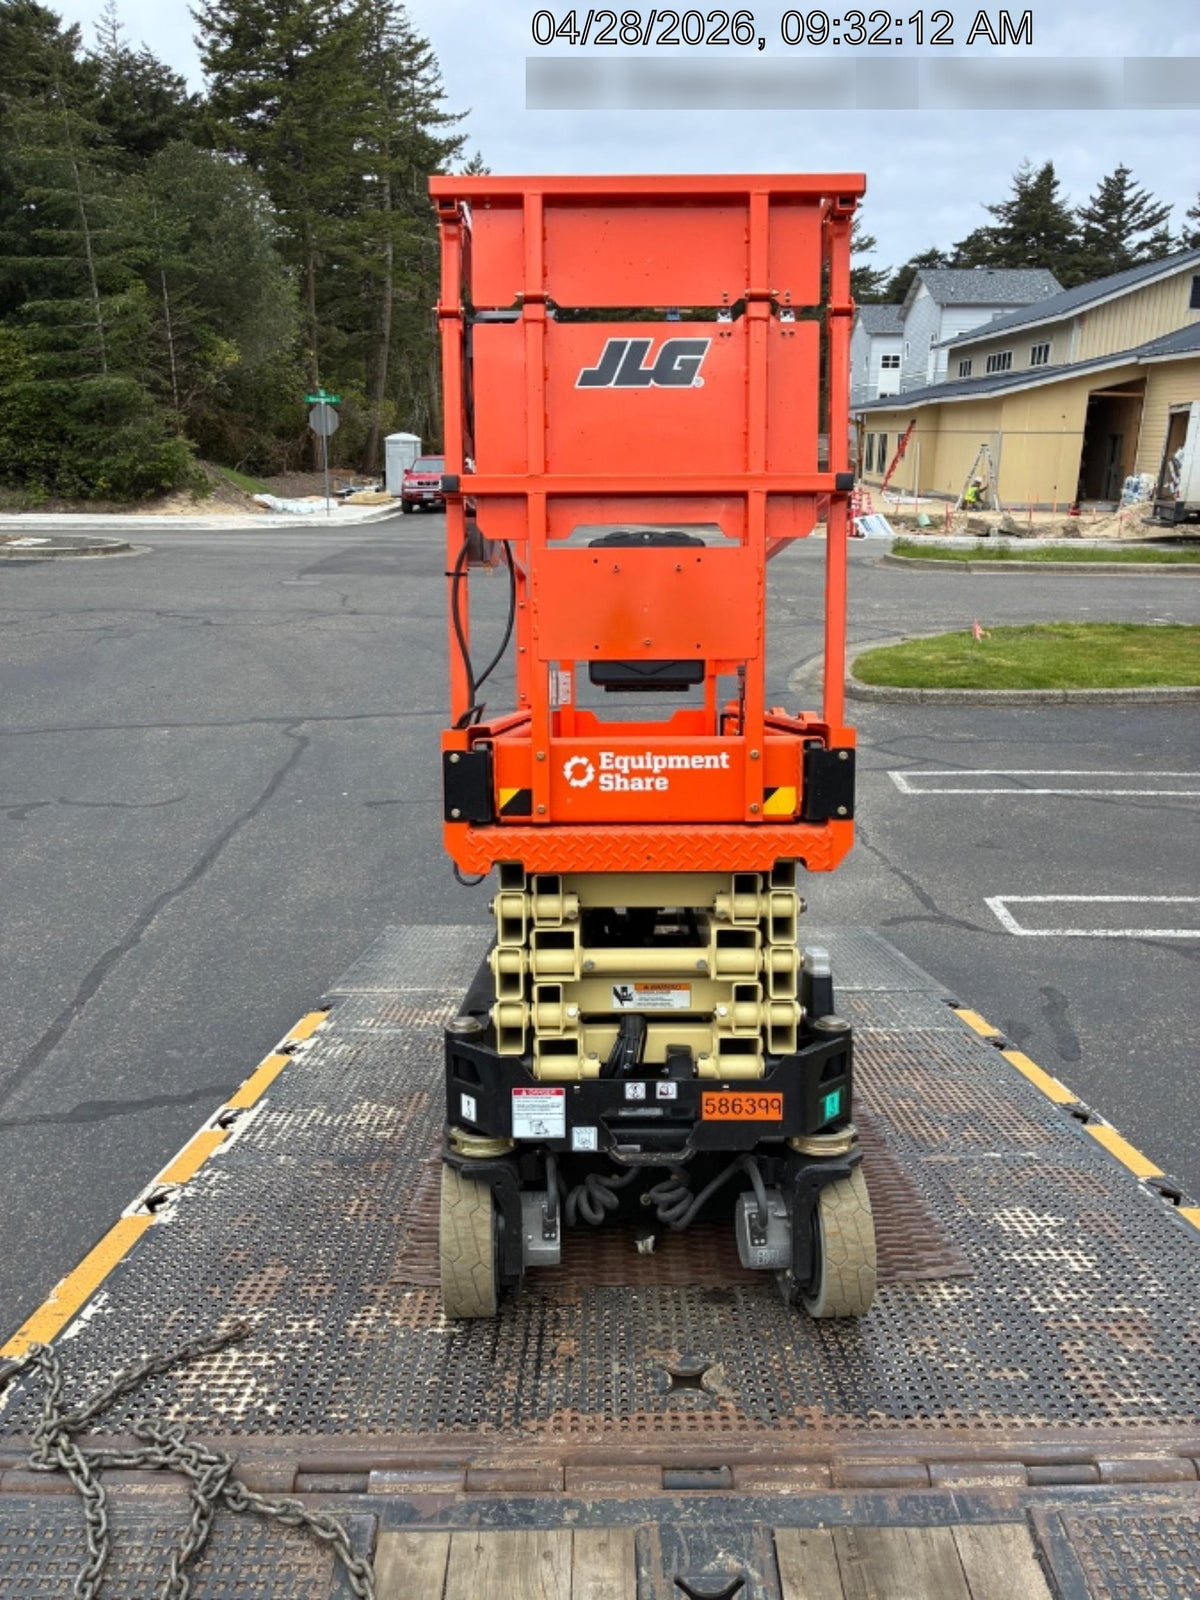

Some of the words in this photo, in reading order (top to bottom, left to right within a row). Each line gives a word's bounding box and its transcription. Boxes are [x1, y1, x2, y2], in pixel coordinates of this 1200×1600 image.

[574, 337, 713, 388] JLG
[599, 752, 729, 773] Equipment
[599, 774, 669, 791] Share
[705, 1097, 781, 1115] 586399
